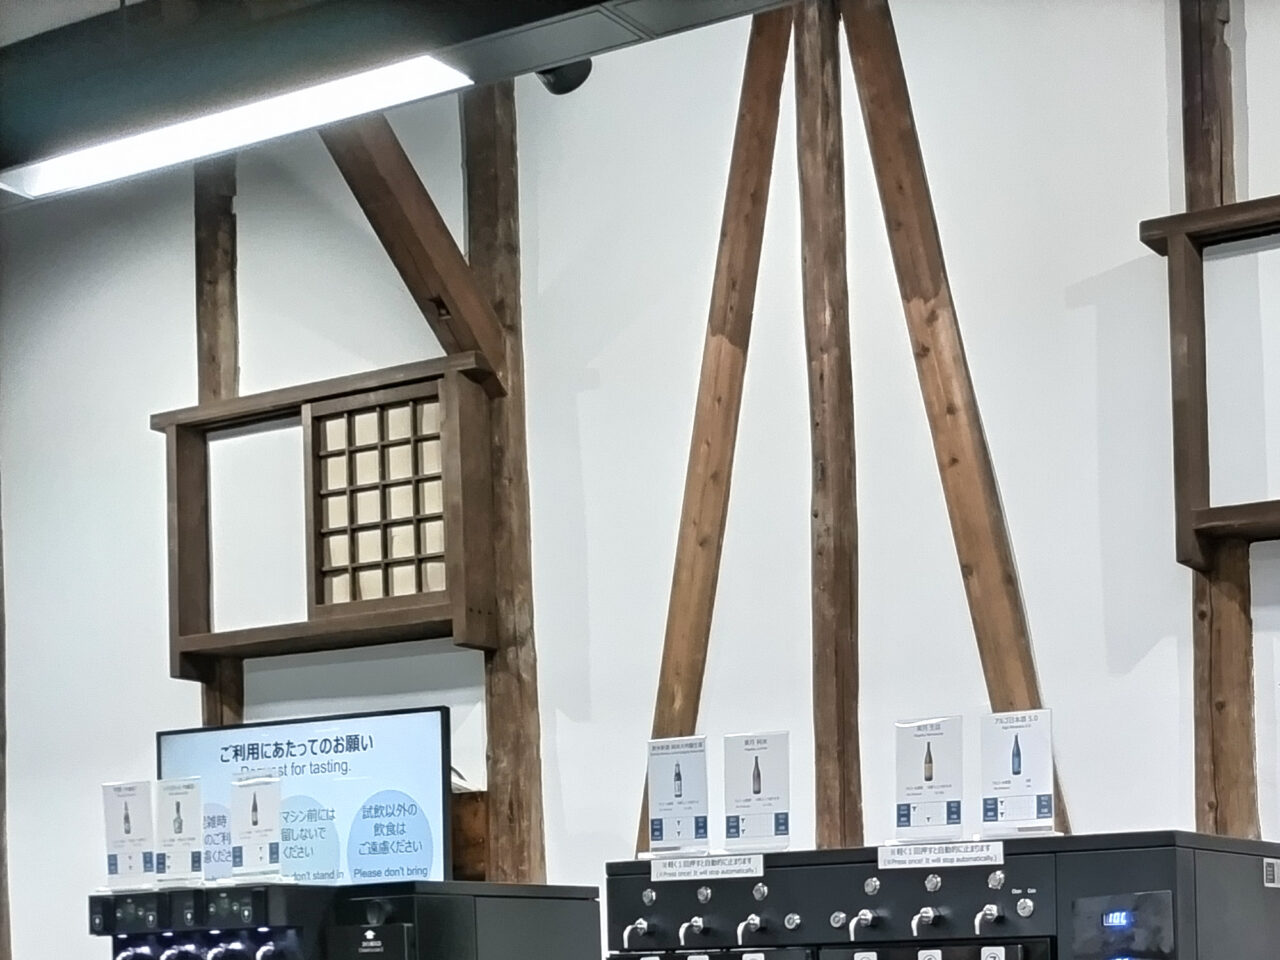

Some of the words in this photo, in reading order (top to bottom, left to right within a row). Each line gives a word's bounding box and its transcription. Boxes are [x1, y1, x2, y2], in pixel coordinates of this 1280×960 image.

[220, 734, 374, 763] ご利用にあたってのお願い
[291, 763, 306, 775] for
[310, 760, 352, 776] tasting.
[281, 808, 336, 823] マシン前には
[362, 802, 418, 819] 試飲以外の
[374, 822, 407, 836] 飲食は
[283, 847, 314, 860] ください
[359, 839, 423, 855] ご遠慮ください
[353, 868, 382, 878] Please
[407, 865, 428, 878] bring
